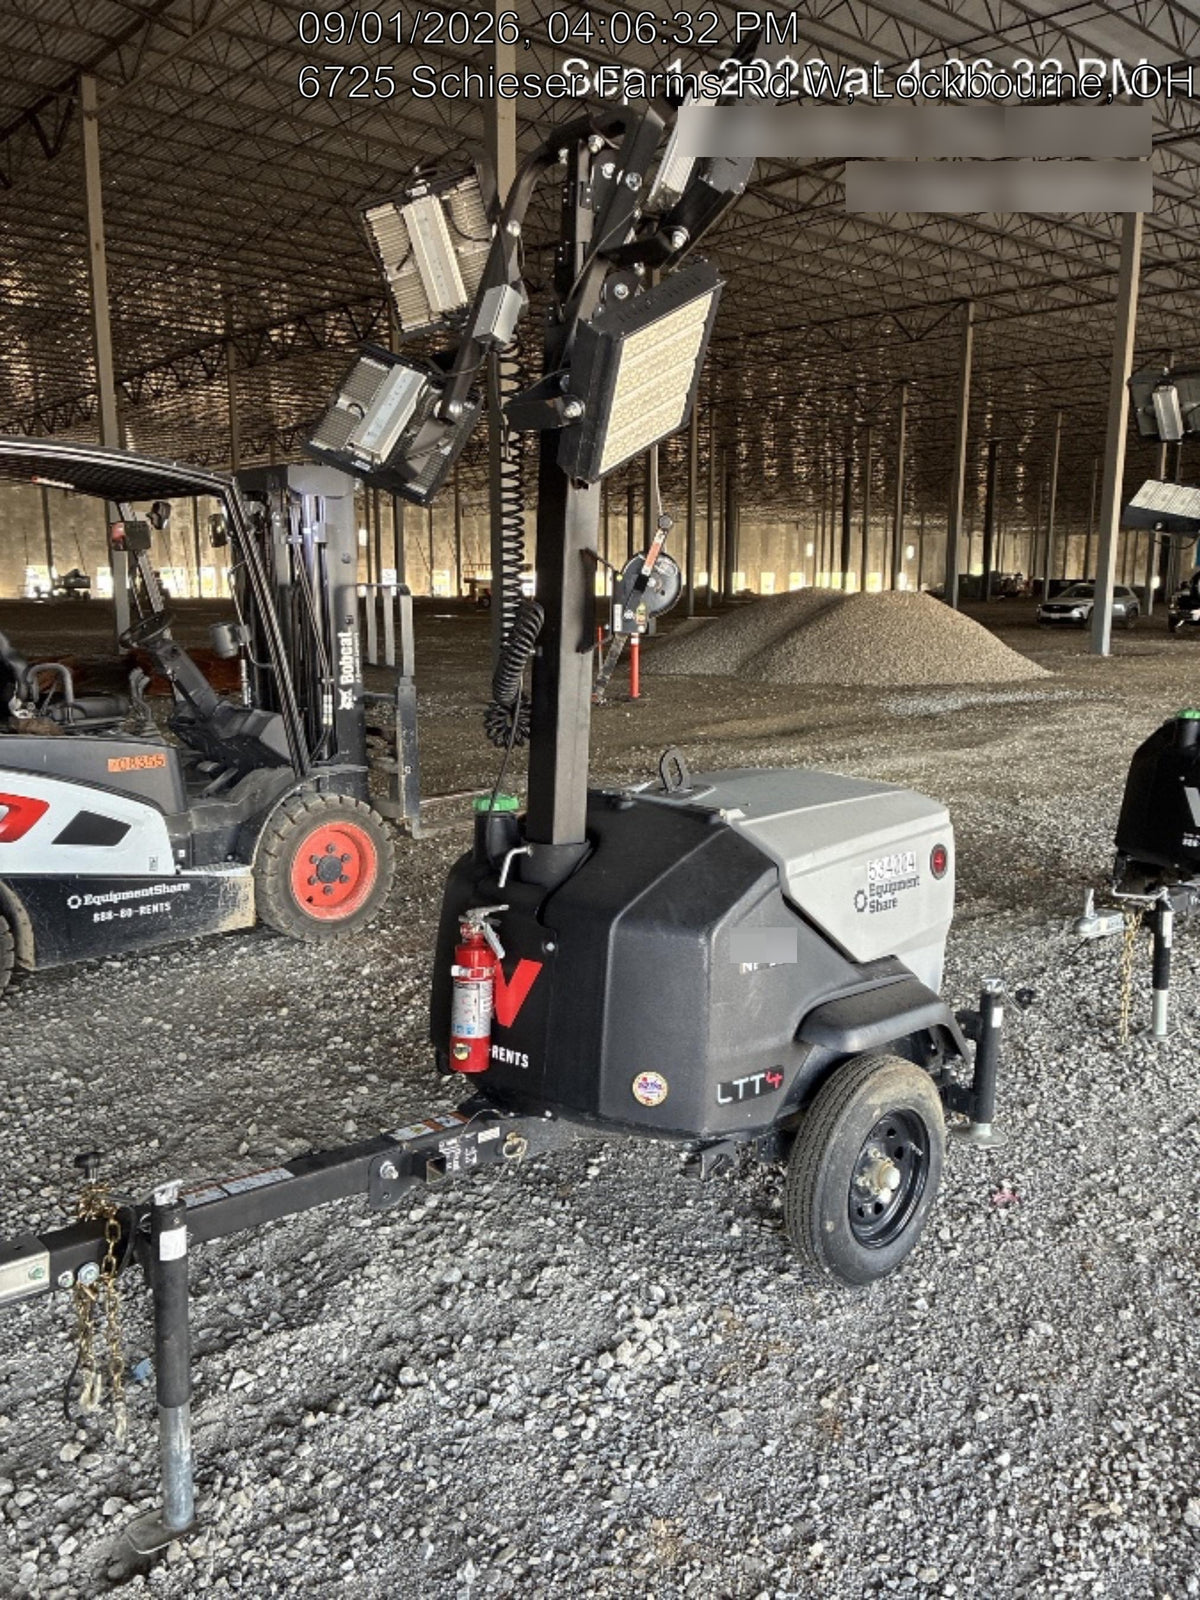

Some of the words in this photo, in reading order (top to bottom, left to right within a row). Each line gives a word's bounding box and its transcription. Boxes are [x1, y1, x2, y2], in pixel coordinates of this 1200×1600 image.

[338, 632, 354, 684] Bobcat
[83, 883, 191, 906] EquipmentShare
[868, 875, 921, 899] Equipment
[868, 898, 898, 914] Share
[717, 1070, 784, 1104] LTT4
